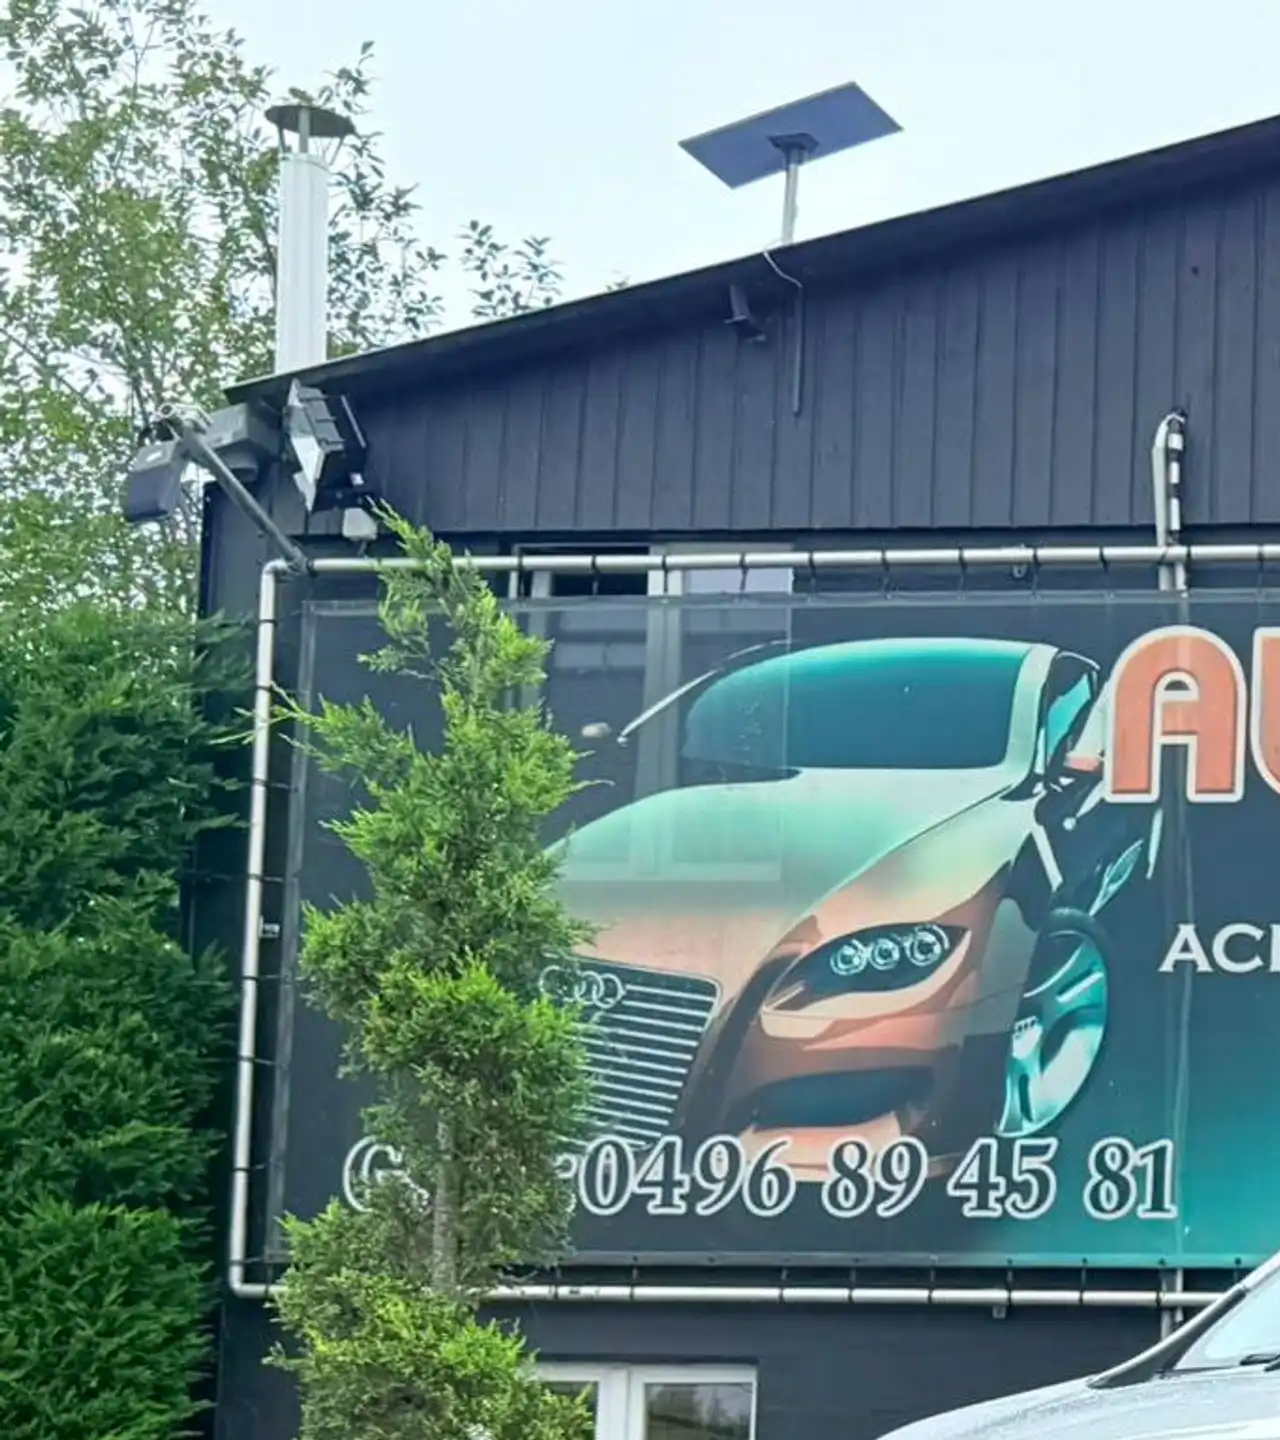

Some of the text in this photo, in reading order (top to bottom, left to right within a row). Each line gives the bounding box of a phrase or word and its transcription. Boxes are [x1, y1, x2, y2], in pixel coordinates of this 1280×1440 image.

[578, 1132, 797, 1219] 0496
[821, 1133, 927, 1220] 89
[946, 1136, 1059, 1219] 45
[1083, 1137, 1177, 1220] 81
